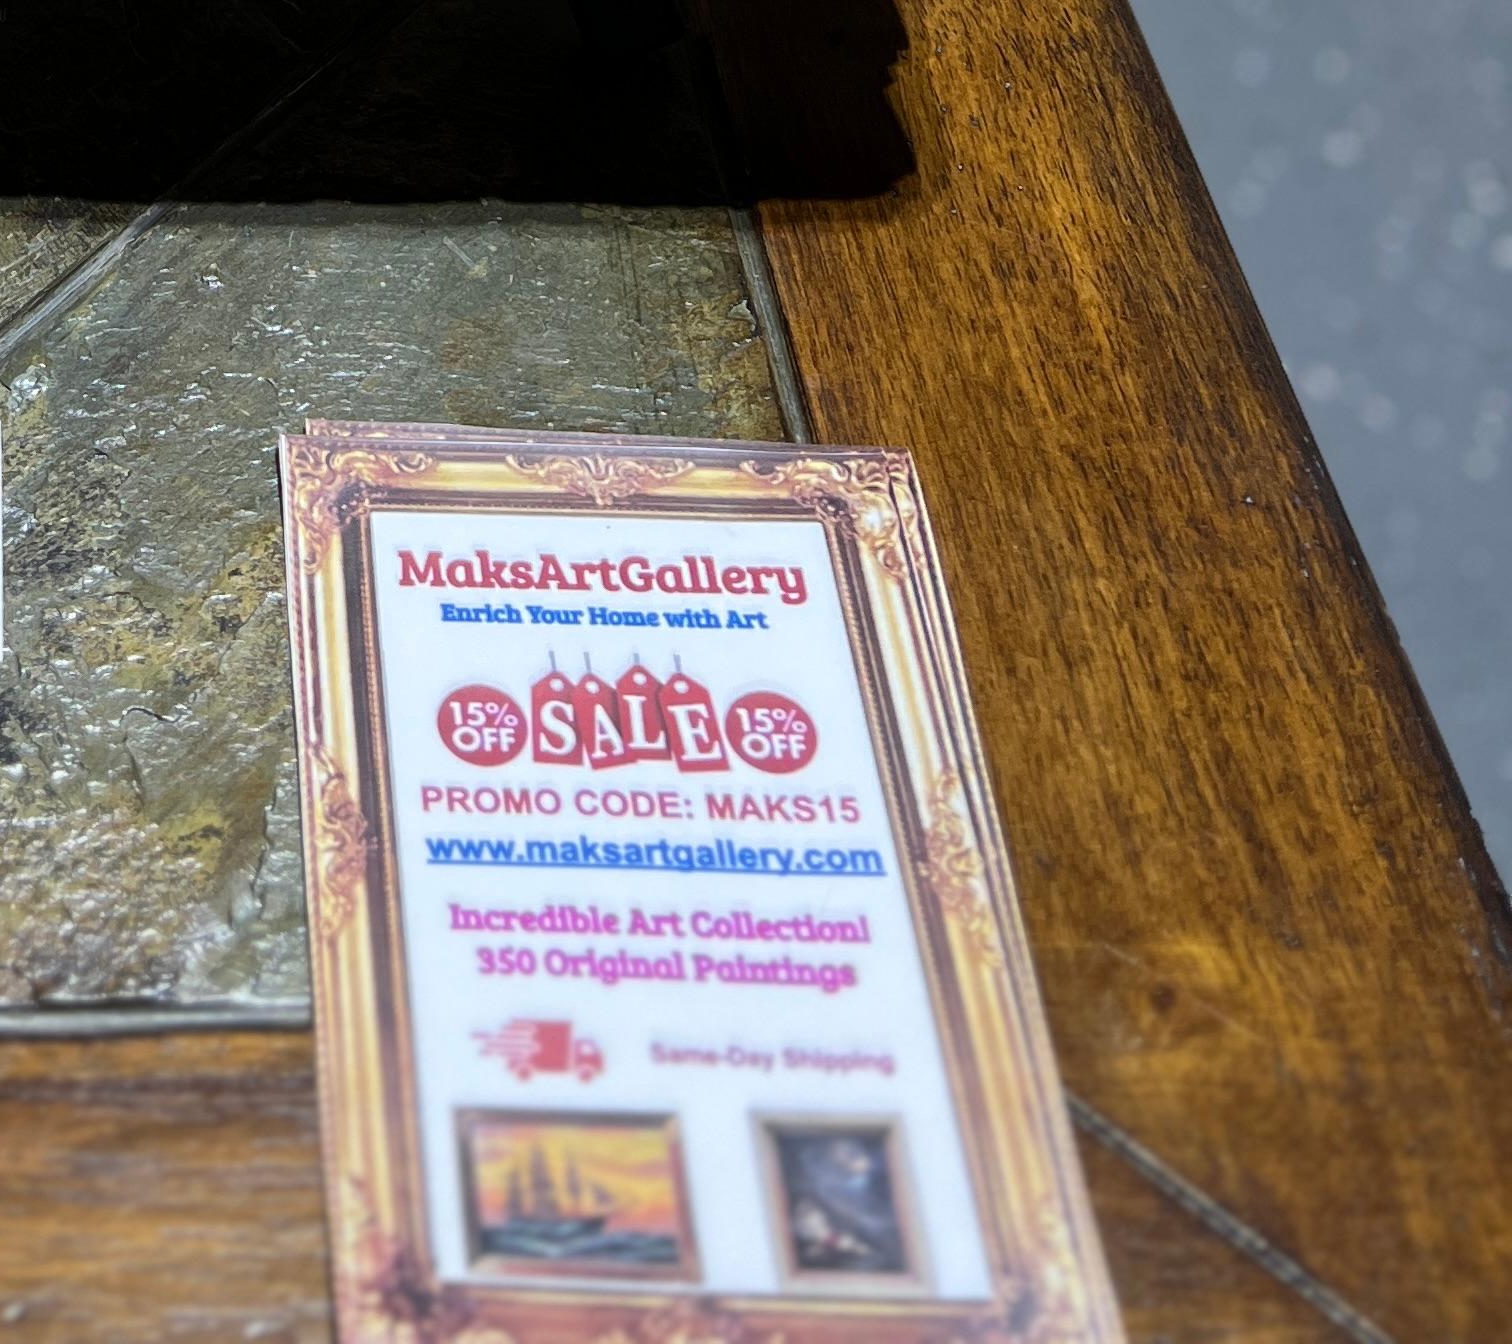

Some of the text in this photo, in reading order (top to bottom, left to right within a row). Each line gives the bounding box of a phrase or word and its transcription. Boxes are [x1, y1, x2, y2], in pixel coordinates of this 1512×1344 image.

[398, 549, 808, 605] MaksArtGallery
[440, 603, 769, 629] Enrich Your Home with Art
[449, 701, 518, 727] 15%
[539, 695, 722, 761] SALE
[735, 707, 807, 734] 15%
[451, 726, 516, 752] OFF
[741, 733, 806, 760] OFF
[421, 786, 861, 823] PROMO CODE: MAKS15
[426, 836, 884, 876] www.maksartgallery.com
[448, 903, 619, 936] Incredible
[628, 910, 685, 937] Art
[476, 947, 858, 994] 350 Original Paintings
[650, 1042, 896, 1076] Same-Day Shipping
